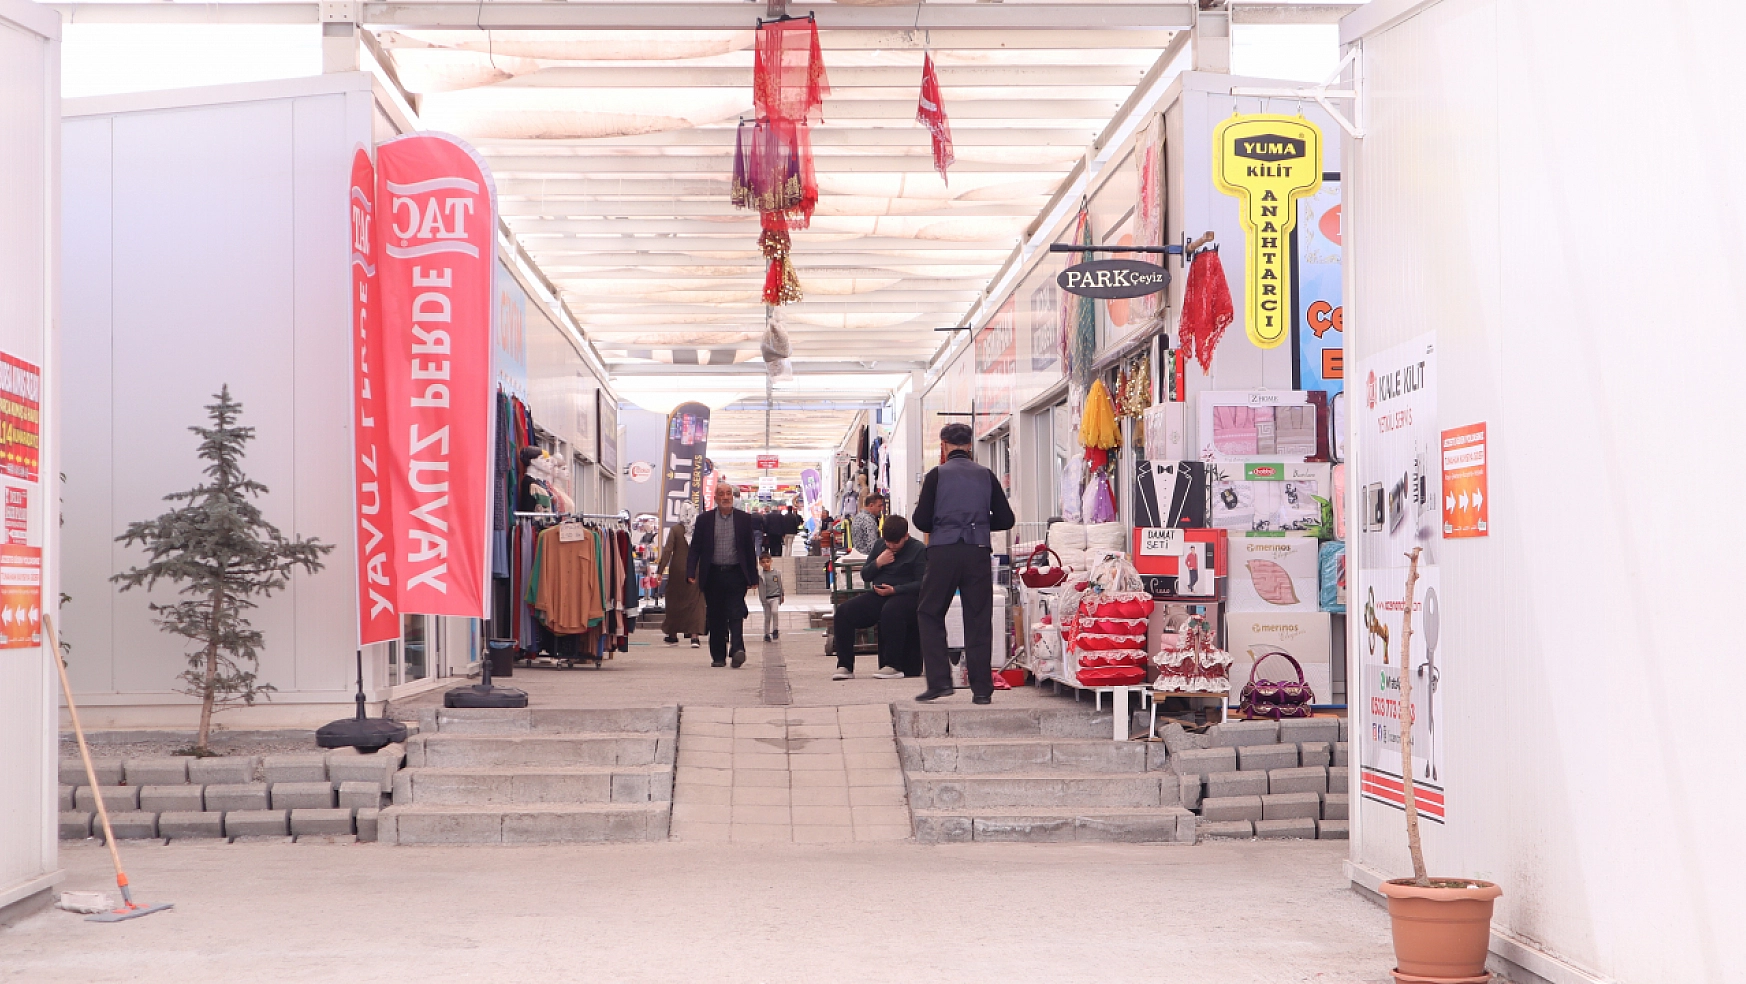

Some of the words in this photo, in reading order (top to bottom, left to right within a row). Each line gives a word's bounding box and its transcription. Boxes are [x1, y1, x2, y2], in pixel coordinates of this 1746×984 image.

[1244, 142, 1297, 155] YUMA
[1247, 163, 1293, 178] KİLİT
[1261, 189, 1278, 328] ANAHTARCI
[1066, 268, 1130, 289] PARK
[1130, 271, 1163, 286] Çeyiz
[1379, 370, 1401, 402] KALE
[1259, 395, 1279, 403] HOME
[361, 444, 395, 621] YAVUZ
[1148, 530, 1175, 540] DAMAT
[1146, 540, 1169, 549] SETİ
[1255, 543, 1291, 552] merinos
[1261, 624, 1299, 632] merinos
